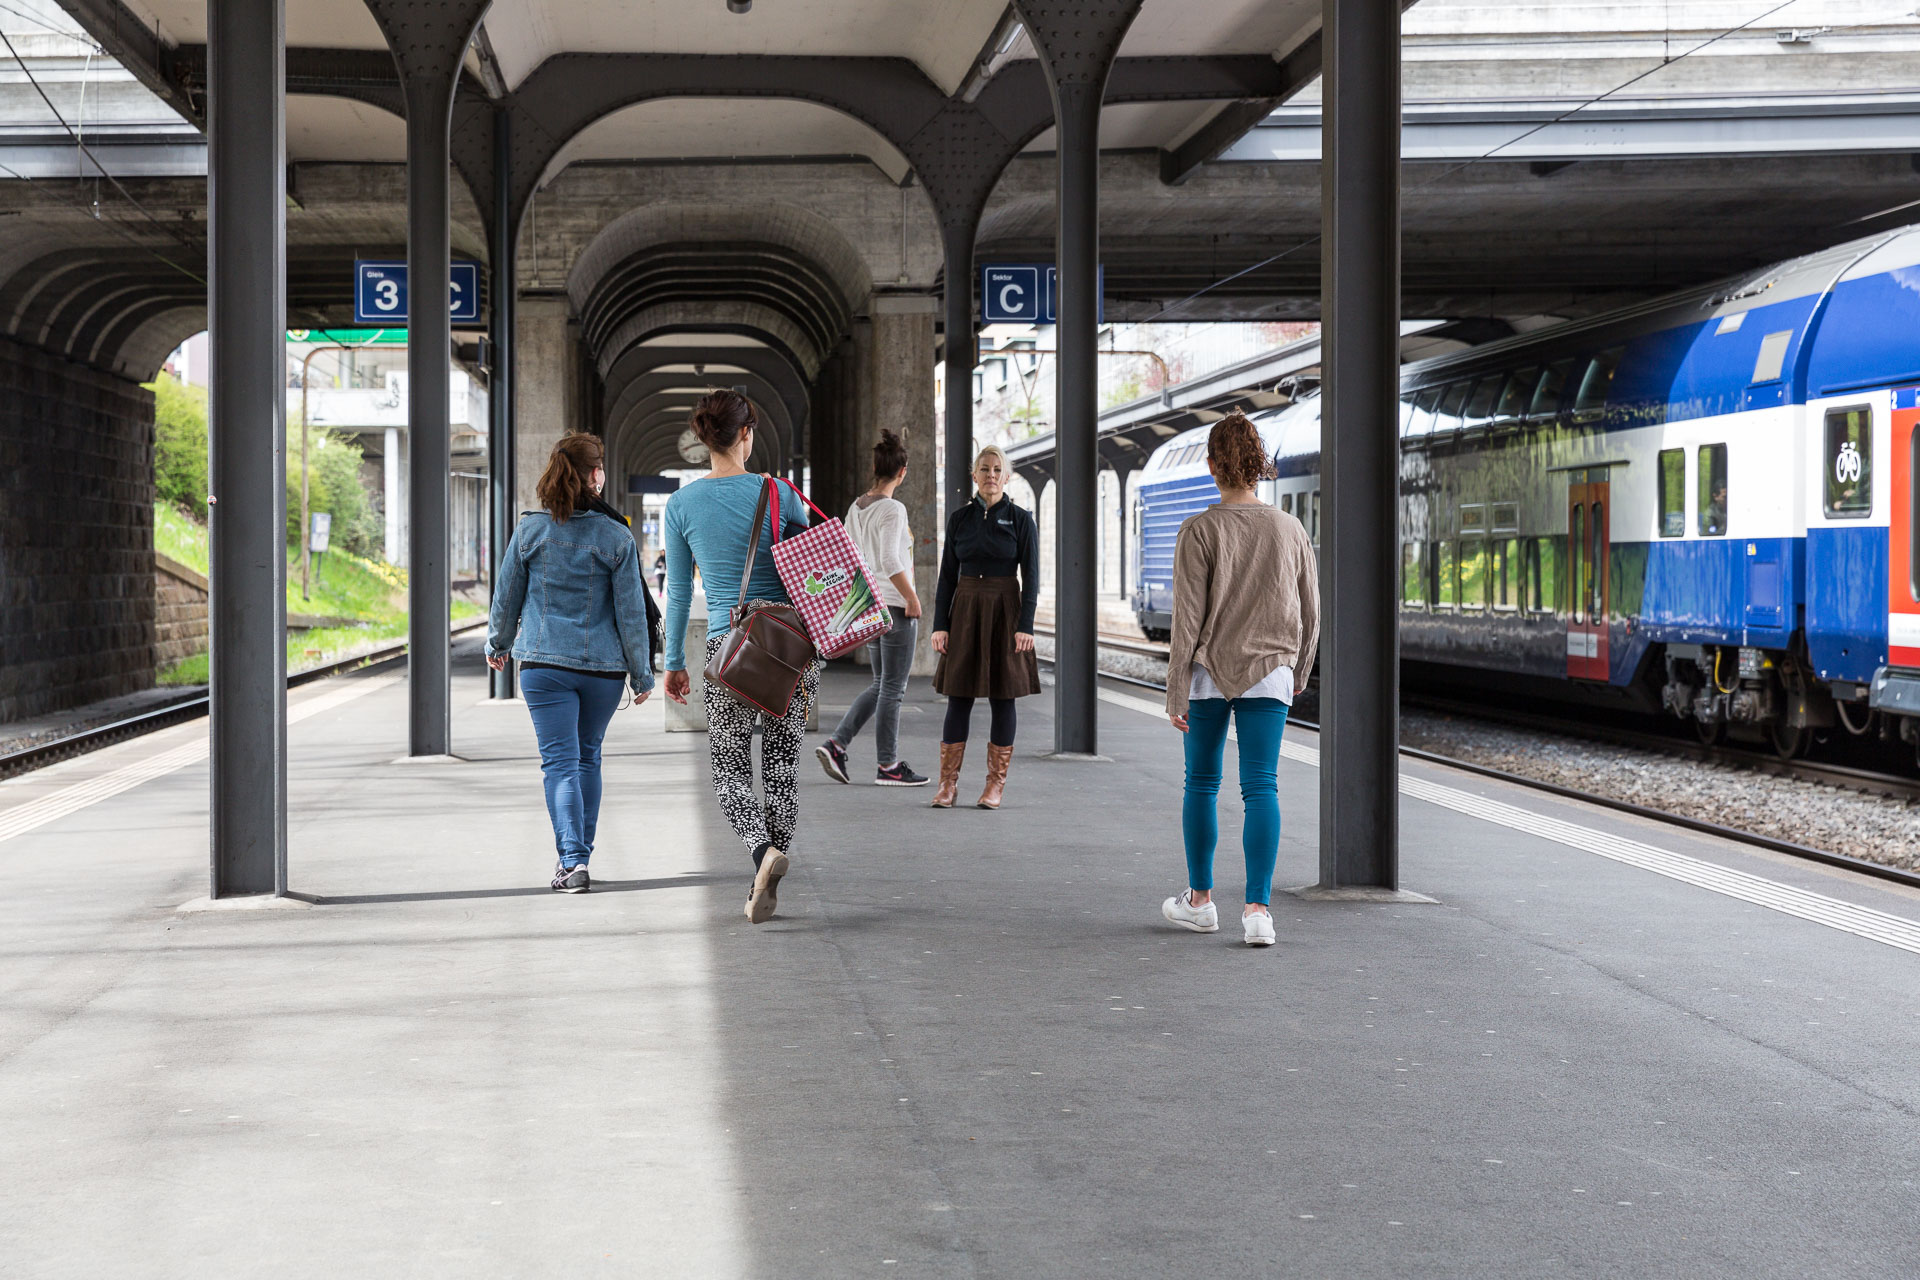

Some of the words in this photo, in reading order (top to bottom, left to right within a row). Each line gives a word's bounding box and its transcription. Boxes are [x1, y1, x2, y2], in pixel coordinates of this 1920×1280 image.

[375, 280, 399, 311] 3
[1000, 284, 1024, 313] C
[822, 571, 838, 583] MEINE
[826, 574, 845, 587] REGION
[862, 615, 880, 625] coop
